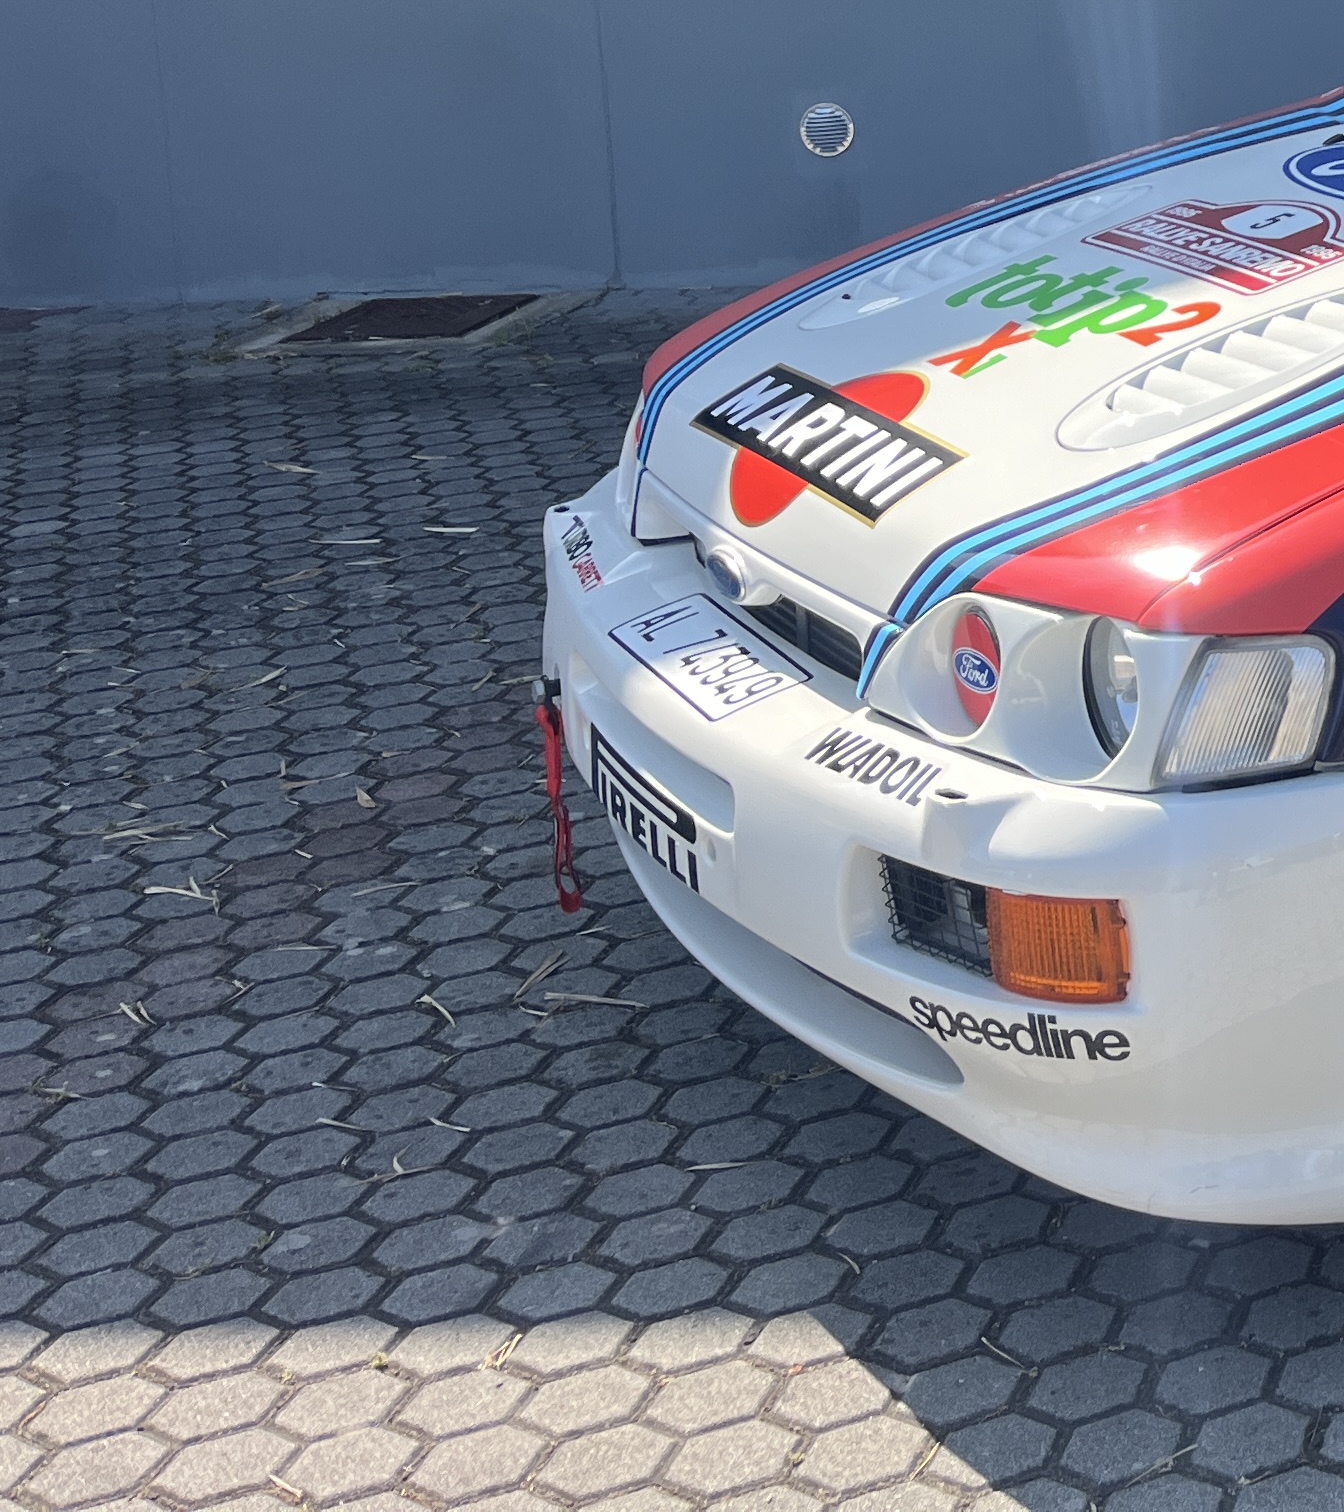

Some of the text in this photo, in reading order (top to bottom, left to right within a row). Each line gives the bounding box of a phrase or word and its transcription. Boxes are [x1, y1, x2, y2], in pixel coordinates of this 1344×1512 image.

[1188, 237, 1305, 276] SANREMO
[710, 373, 945, 510] MARTINI
[630, 605, 700, 643] AL
[959, 655, 990, 687] Ford
[591, 722, 699, 894] PIRELLI
[909, 995, 1132, 1062] speedline
